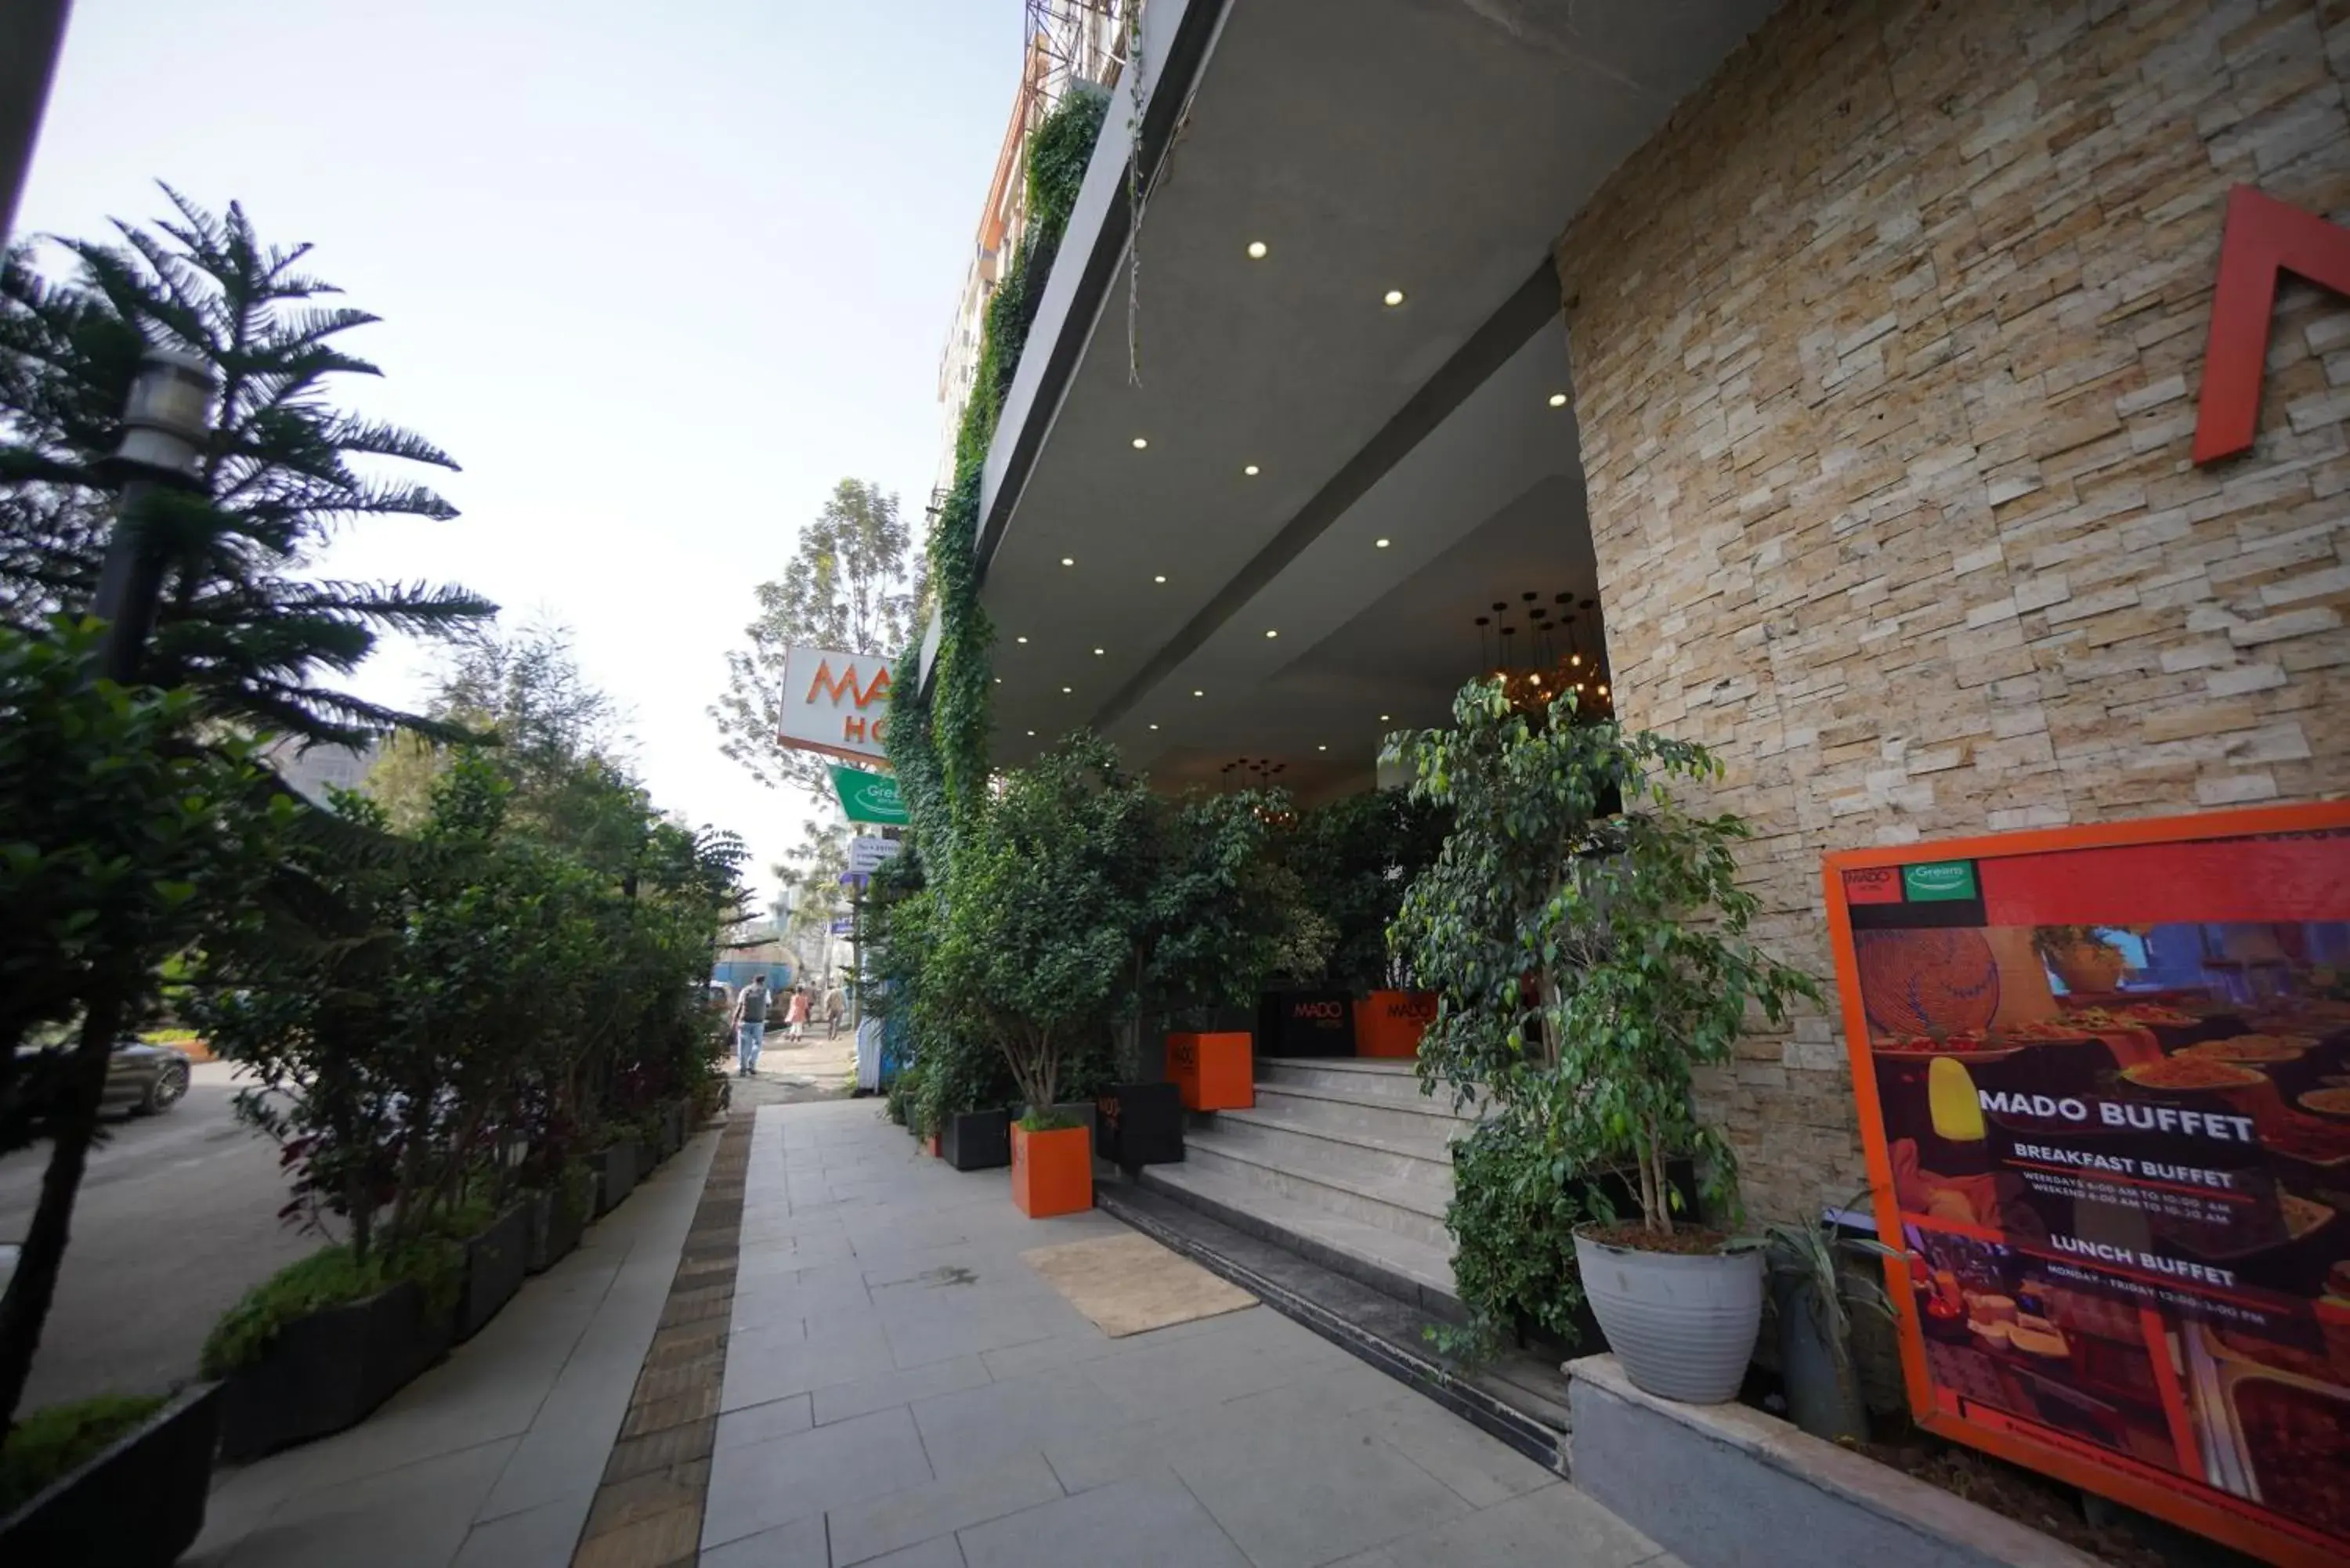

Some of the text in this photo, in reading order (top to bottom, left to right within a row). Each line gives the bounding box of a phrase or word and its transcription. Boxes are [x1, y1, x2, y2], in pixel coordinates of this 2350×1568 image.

[1291, 1001, 1343, 1019] MADO
[1978, 1089, 2254, 1143] MADO BUFFET
[2013, 1141, 2233, 1189] BREAKFAST BUFFET
[2023, 1171, 2084, 1188] WEEKDAYS
[2118, 1187, 2138, 1198] AM
[2140, 1190, 2160, 1201] TO
[2207, 1202, 2231, 1213] AM
[2031, 1182, 2087, 1199] WEEKEND
[2118, 1197, 2141, 1209] AM
[2142, 1201, 2162, 1213] TO
[2205, 1212, 2232, 1226] AM
[2049, 1232, 2235, 1288] LUNCH BUFFET
[2047, 1264, 2099, 1283] MONDAY
[2110, 1277, 2155, 1297] FRIDAY
[2240, 1310, 2267, 1327] PM
